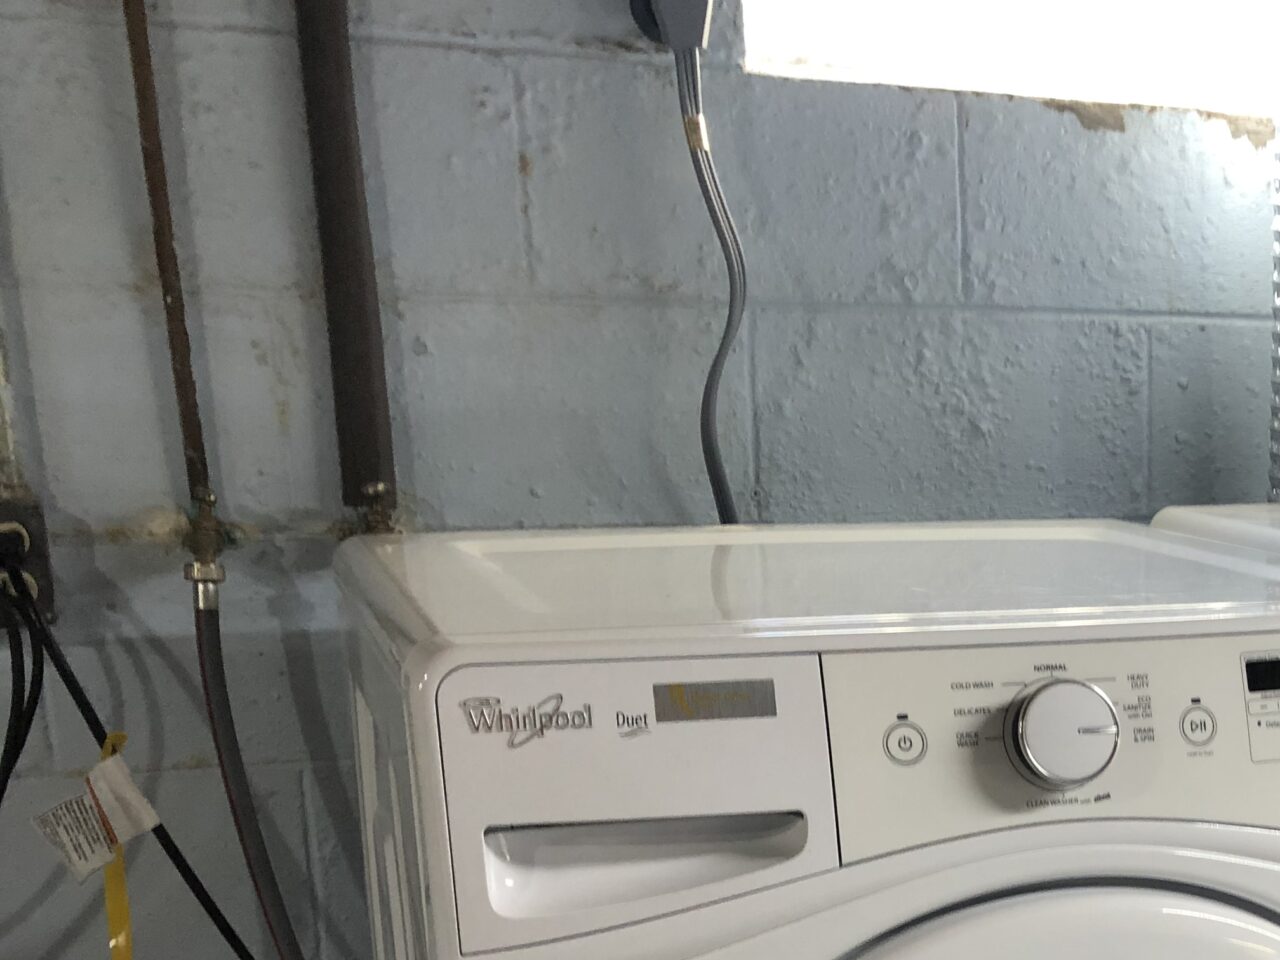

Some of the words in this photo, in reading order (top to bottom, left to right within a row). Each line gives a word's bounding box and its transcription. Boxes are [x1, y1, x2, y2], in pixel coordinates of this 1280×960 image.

[1033, 663, 1067, 673] NORMAL
[950, 682, 973, 690] COLD
[972, 680, 994, 689] WASH
[953, 706, 991, 716] DELICATES
[459, 694, 593, 746] Whirlpool
[616, 711, 649, 730] Duet
